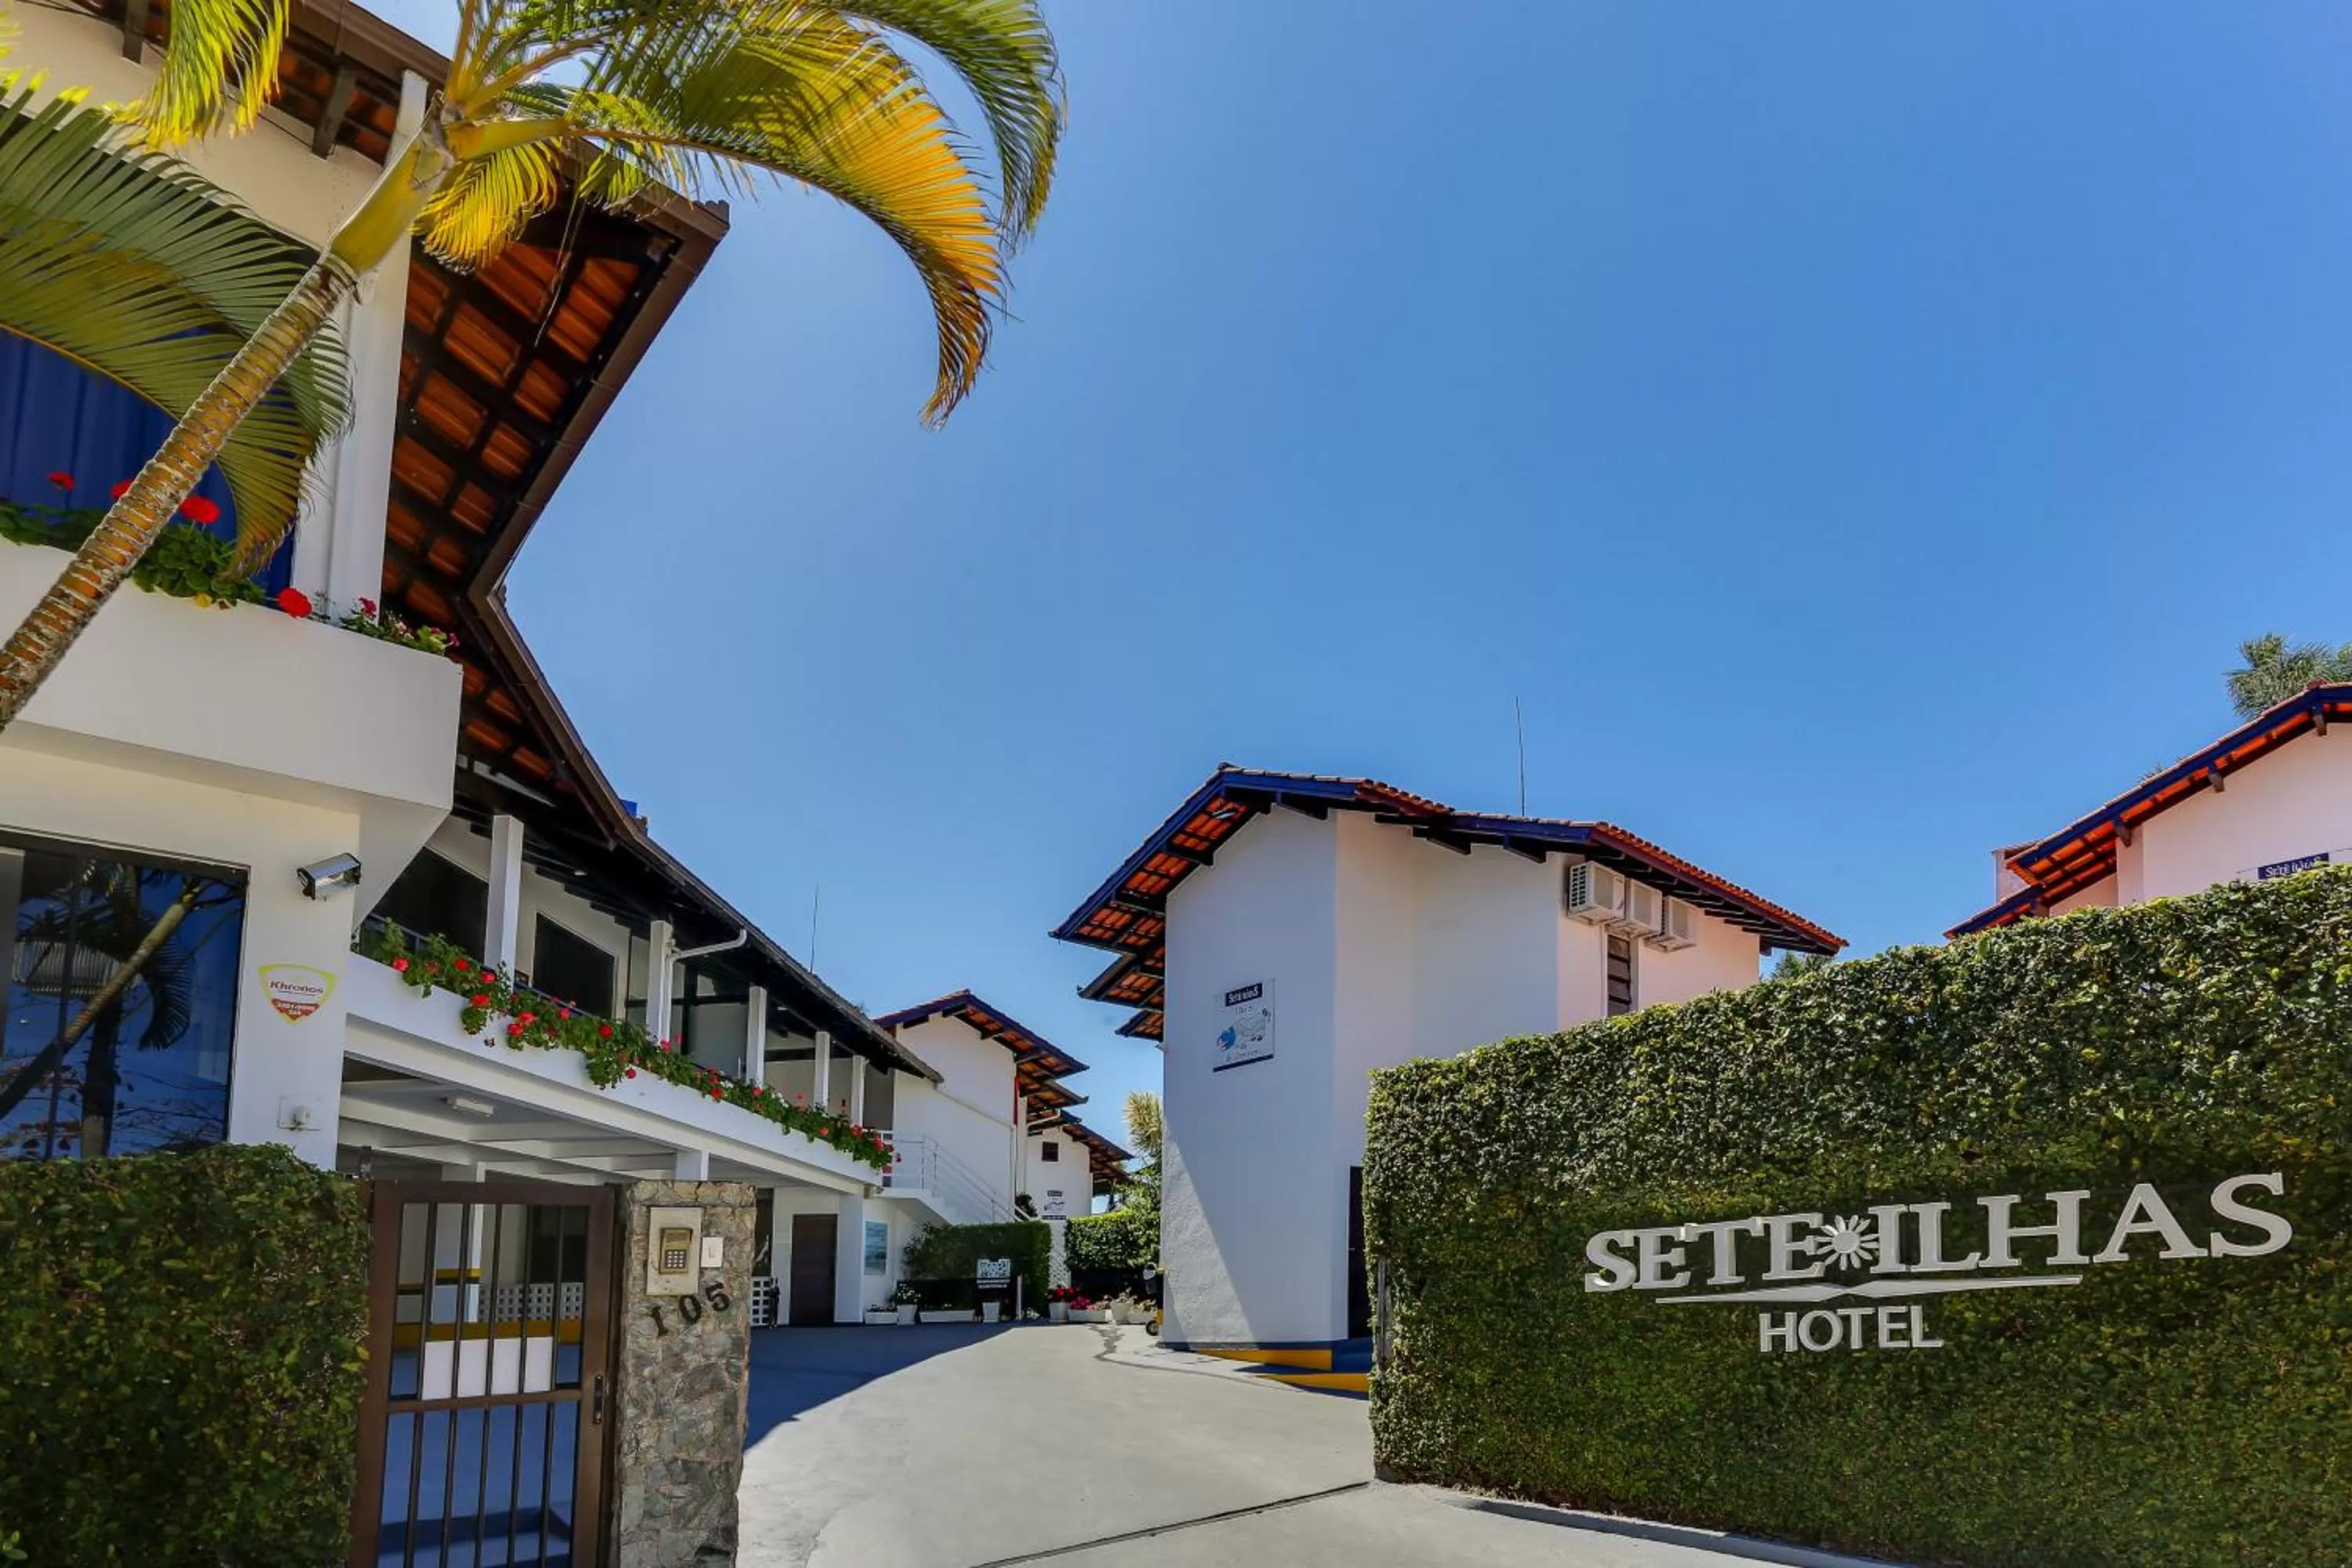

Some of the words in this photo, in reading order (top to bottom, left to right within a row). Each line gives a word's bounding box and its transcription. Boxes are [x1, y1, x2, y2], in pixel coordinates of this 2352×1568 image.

[1585, 1213, 1826, 1292] SETE
[1867, 1172, 2292, 1274] ILHAS
[652, 1283, 730, 1337] 105
[1759, 1305, 1944, 1352] HOTEL
